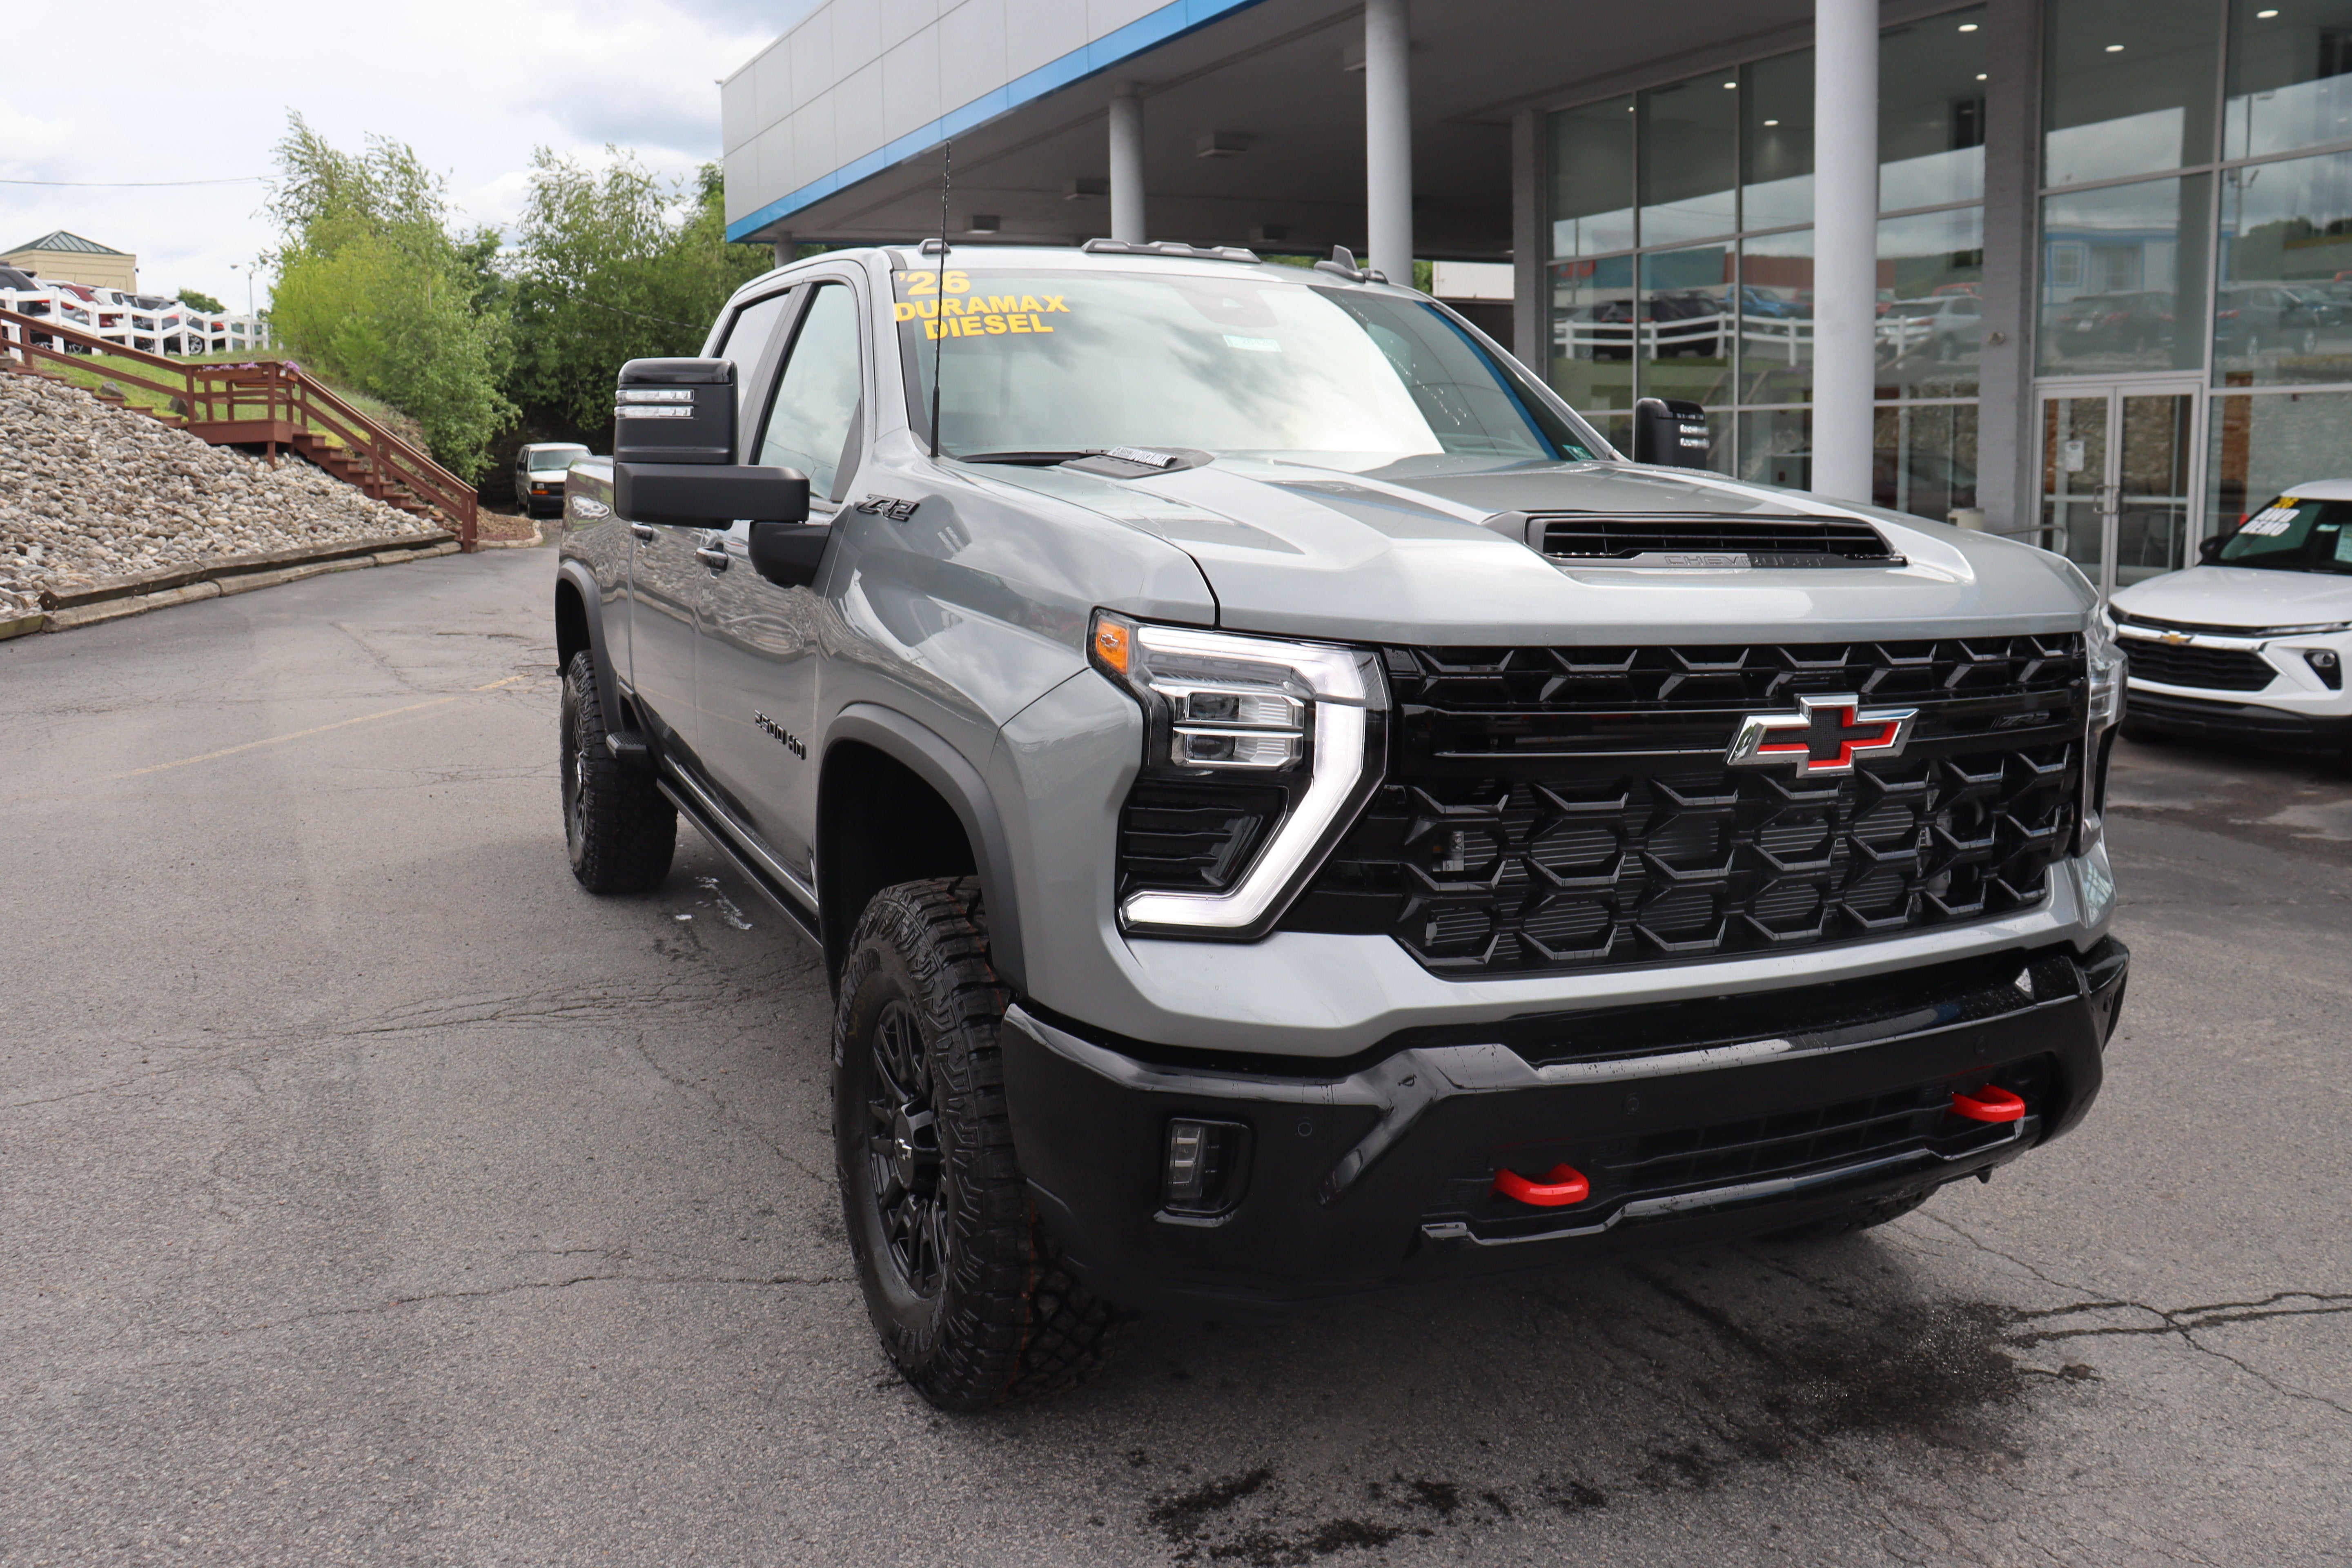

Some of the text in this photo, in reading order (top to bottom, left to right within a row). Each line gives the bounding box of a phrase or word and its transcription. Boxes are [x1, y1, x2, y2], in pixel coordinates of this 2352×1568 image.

[894, 295, 1070, 322] DURAMAX
[923, 314, 1054, 340] DIESEL
[857, 494, 920, 522] ZR2
[2239, 520, 2291, 536] DEMO
[755, 709, 806, 760] 2500 HD
